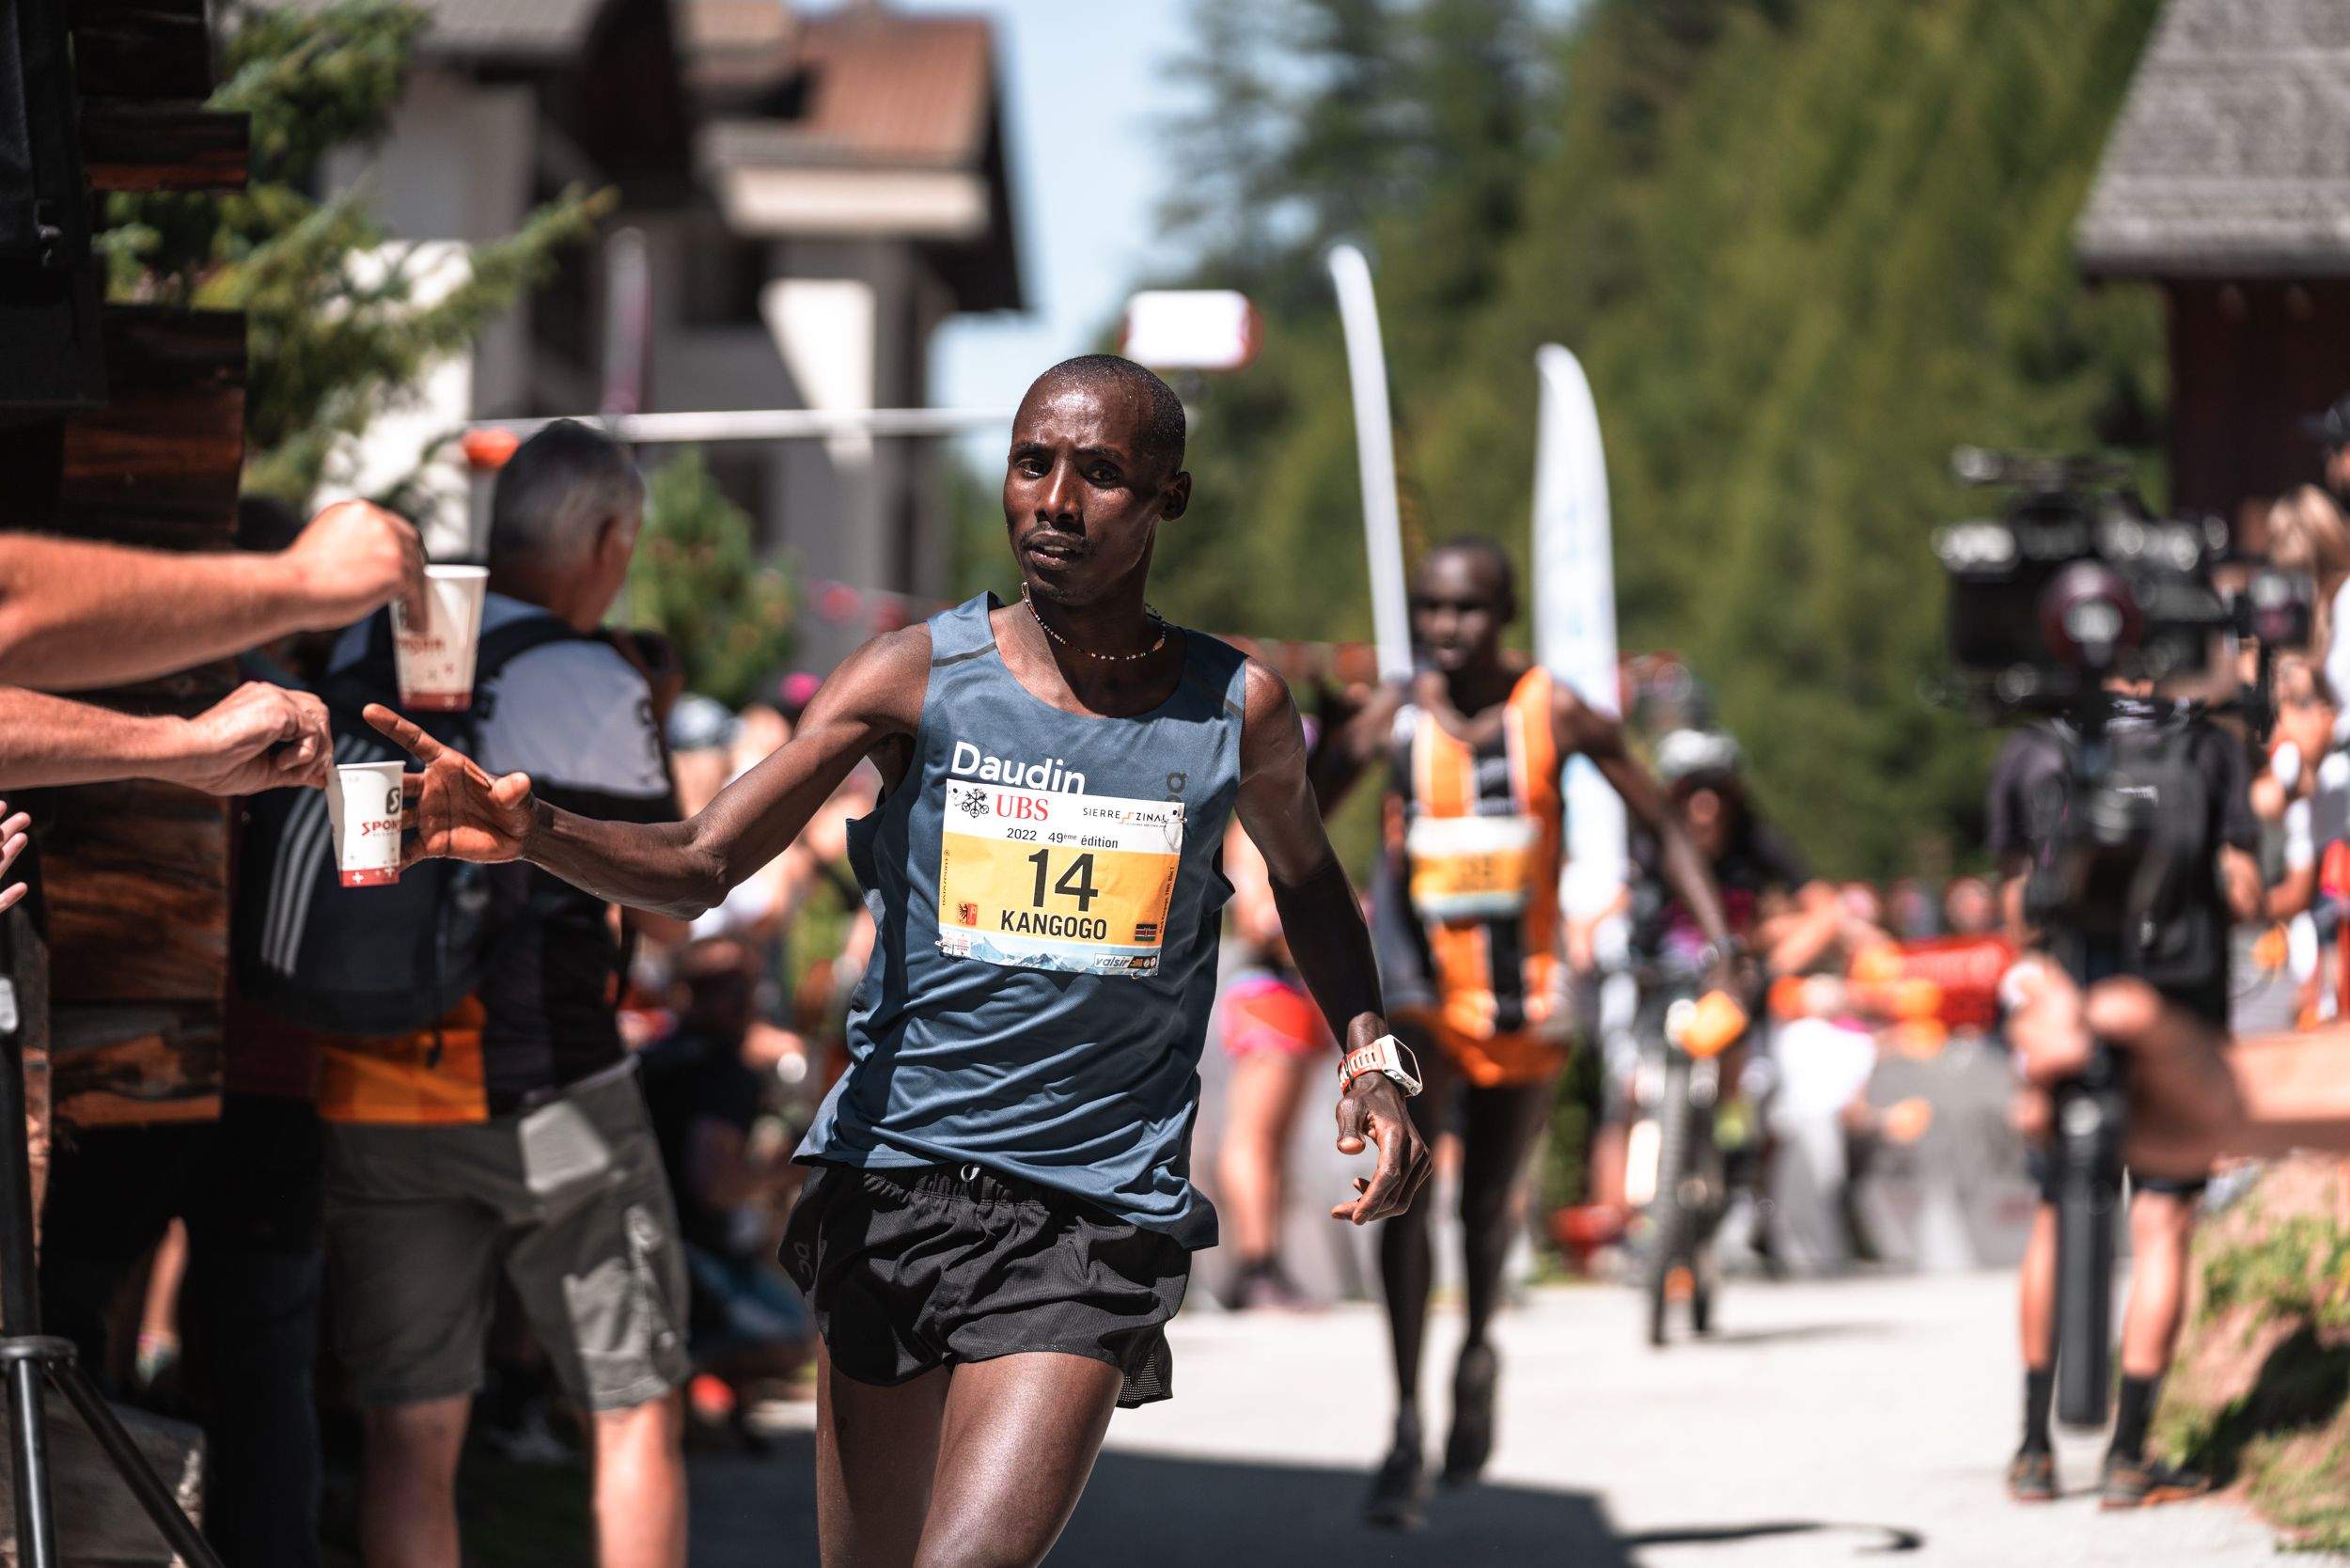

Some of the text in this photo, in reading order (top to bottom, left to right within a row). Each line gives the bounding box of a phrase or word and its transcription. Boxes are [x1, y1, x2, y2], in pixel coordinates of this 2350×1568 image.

[951, 741, 1086, 795] Daudin
[996, 793, 1049, 821] UBS
[1083, 808, 1168, 823] SIERRE ZINAL
[1007, 828, 1119, 849] 2022 49ème édition
[1028, 848, 1098, 912] 14
[1000, 909, 1107, 940] KANGOGO
[1094, 956, 1131, 967] valsir
